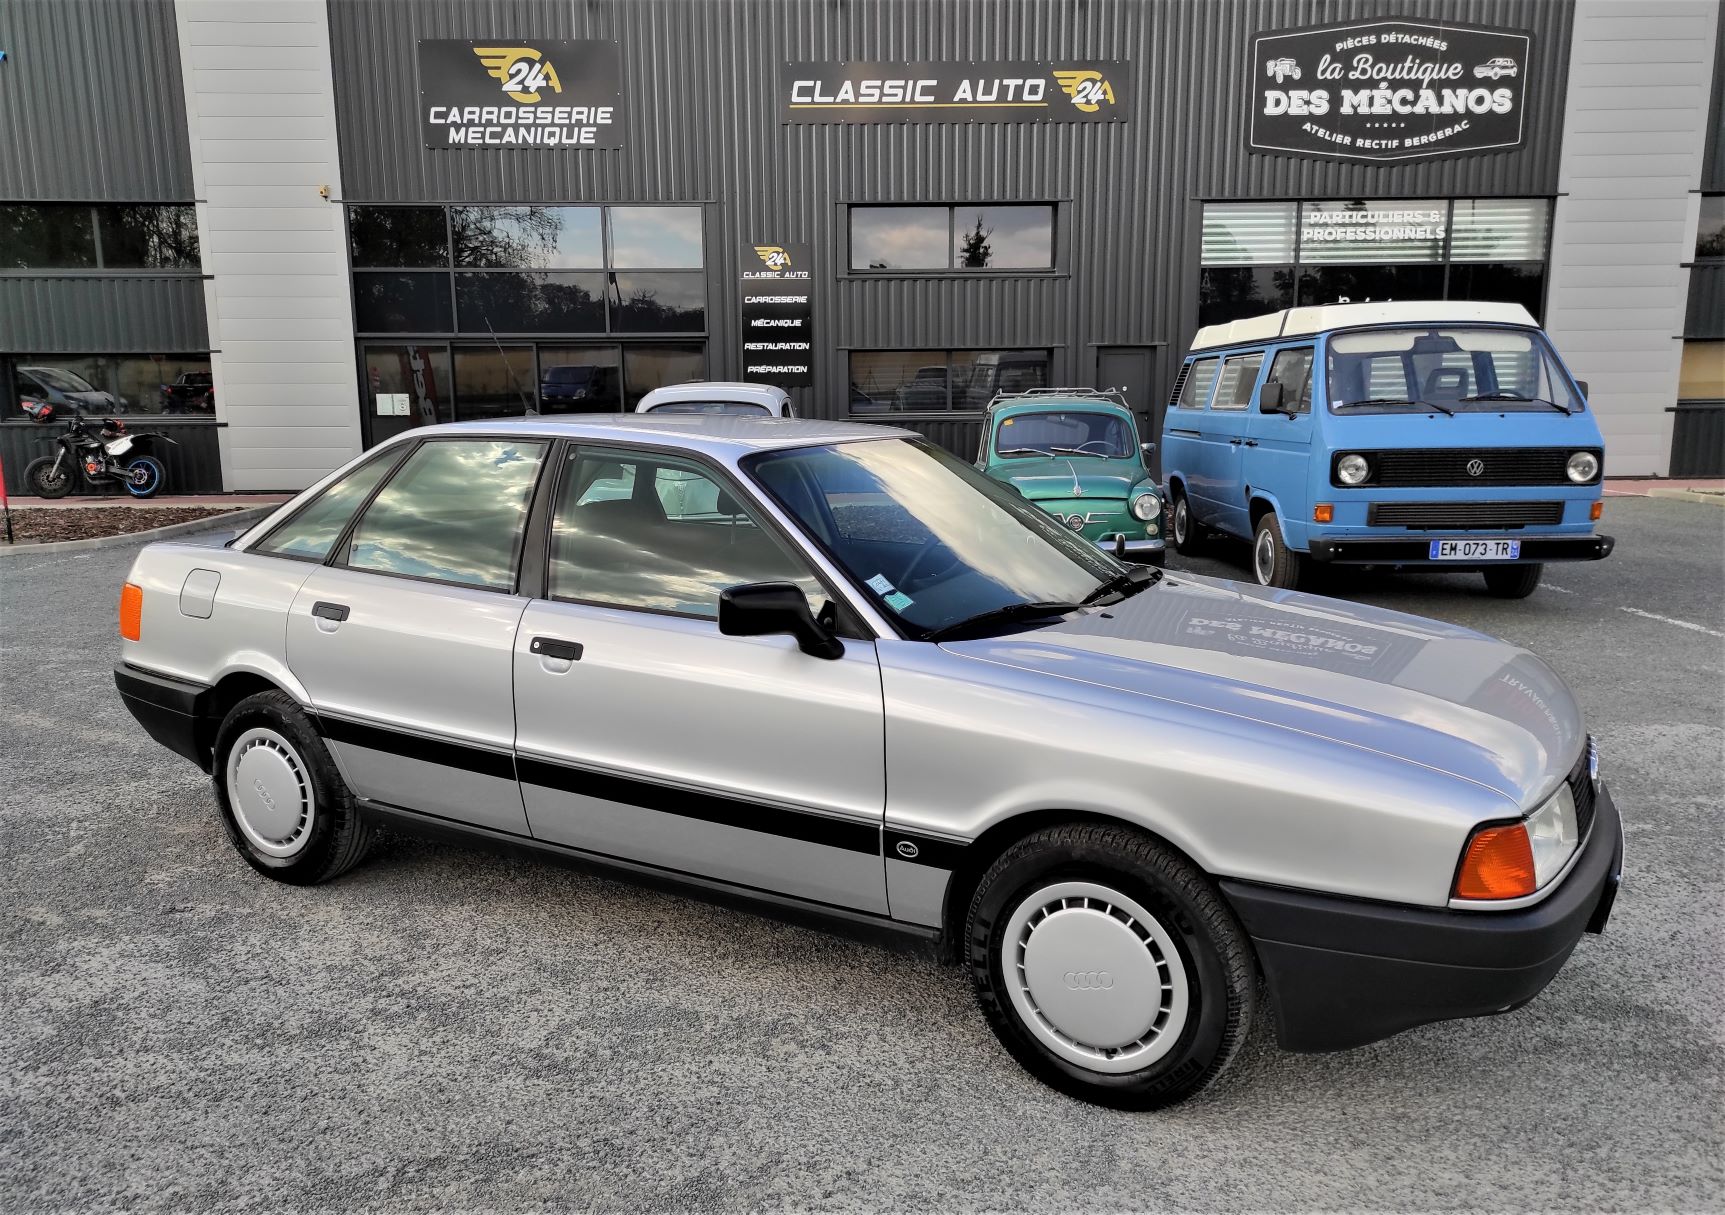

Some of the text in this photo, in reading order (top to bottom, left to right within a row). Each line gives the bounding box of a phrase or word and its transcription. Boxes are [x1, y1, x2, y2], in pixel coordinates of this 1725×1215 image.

[1336, 32, 1448, 52] PIÈCES DÉTACHÉES
[1317, 54, 1463, 88] la Boutique
[791, 79, 1045, 103] CLASSIC AUTO
[1264, 82, 1512, 115] DES MÉCANOS
[430, 107, 613, 124] CARROSSERIE
[449, 127, 596, 146] MECANIQUE
[1302, 120, 1470, 149] ATELIER RECTIF BERGERAC
[1310, 210, 1441, 224] PARTICULIERS &
[1303, 226, 1446, 241] PROFESSIONNELS
[744, 296, 808, 304] CARROSSERIE
[751, 318, 802, 327] MÉCANIQUE
[744, 342, 810, 350] RESTAURATION
[747, 365, 808, 374] PRÉPARATION
[1440, 542, 1509, 556] EM-073-TR
